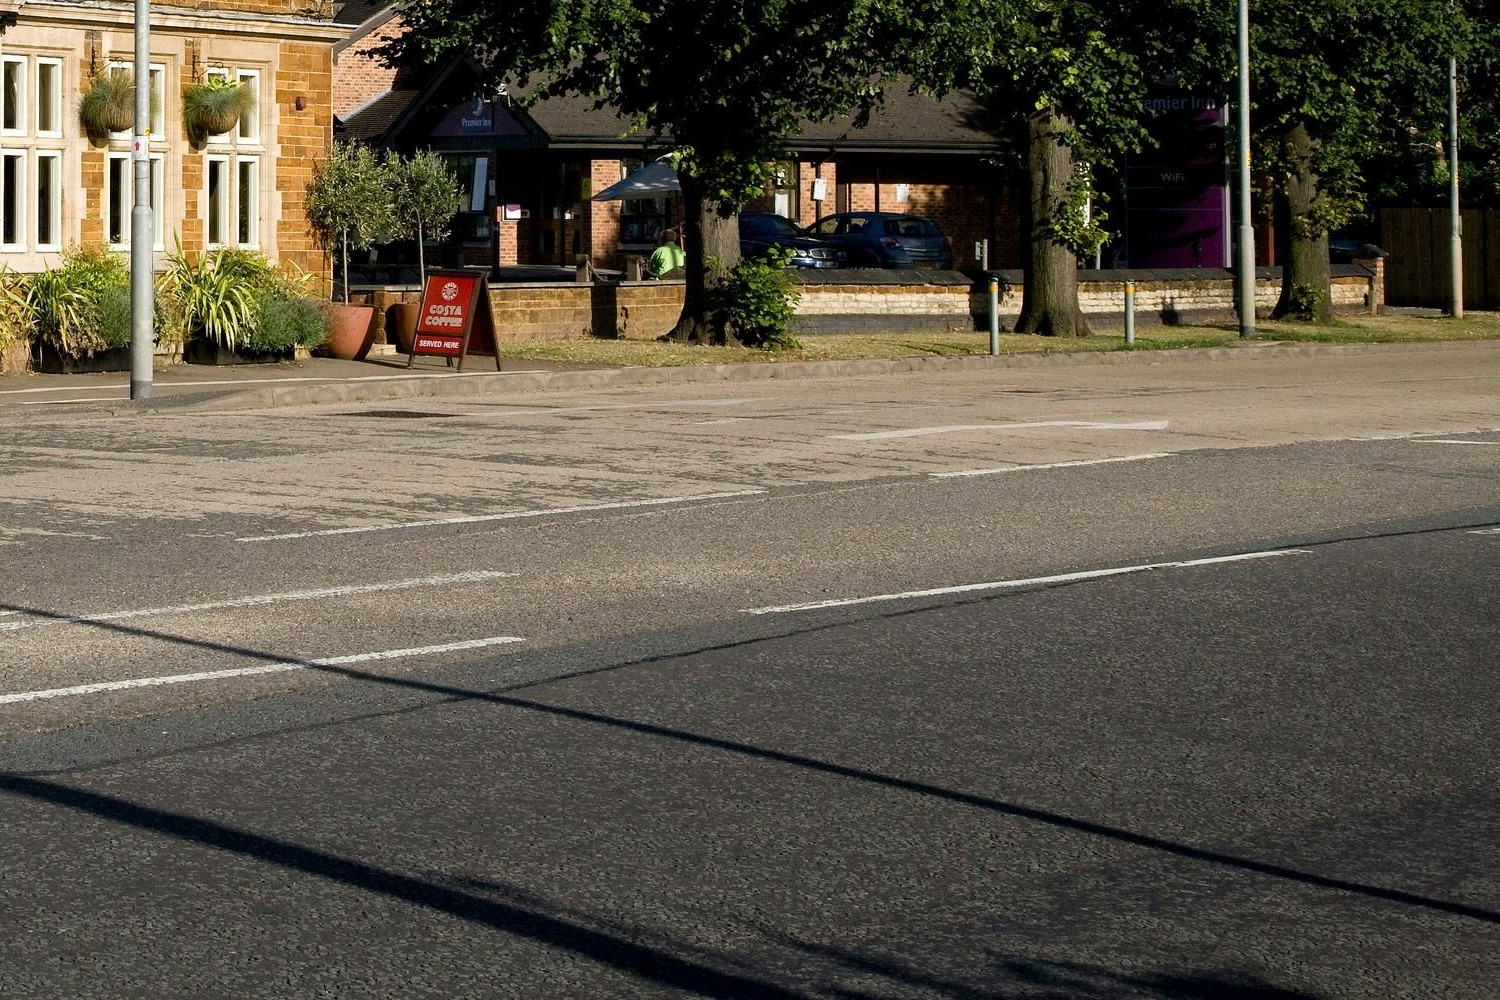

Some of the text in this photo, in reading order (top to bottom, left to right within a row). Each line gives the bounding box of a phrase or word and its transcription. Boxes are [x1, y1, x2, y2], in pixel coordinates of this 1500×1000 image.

[1142, 96, 1188, 110] emier
[1159, 172, 1185, 182] WiFi
[430, 304, 462, 316] COSTA
[425, 315, 463, 327] COFFEE
[419, 340, 460, 349] SERVED HERE
